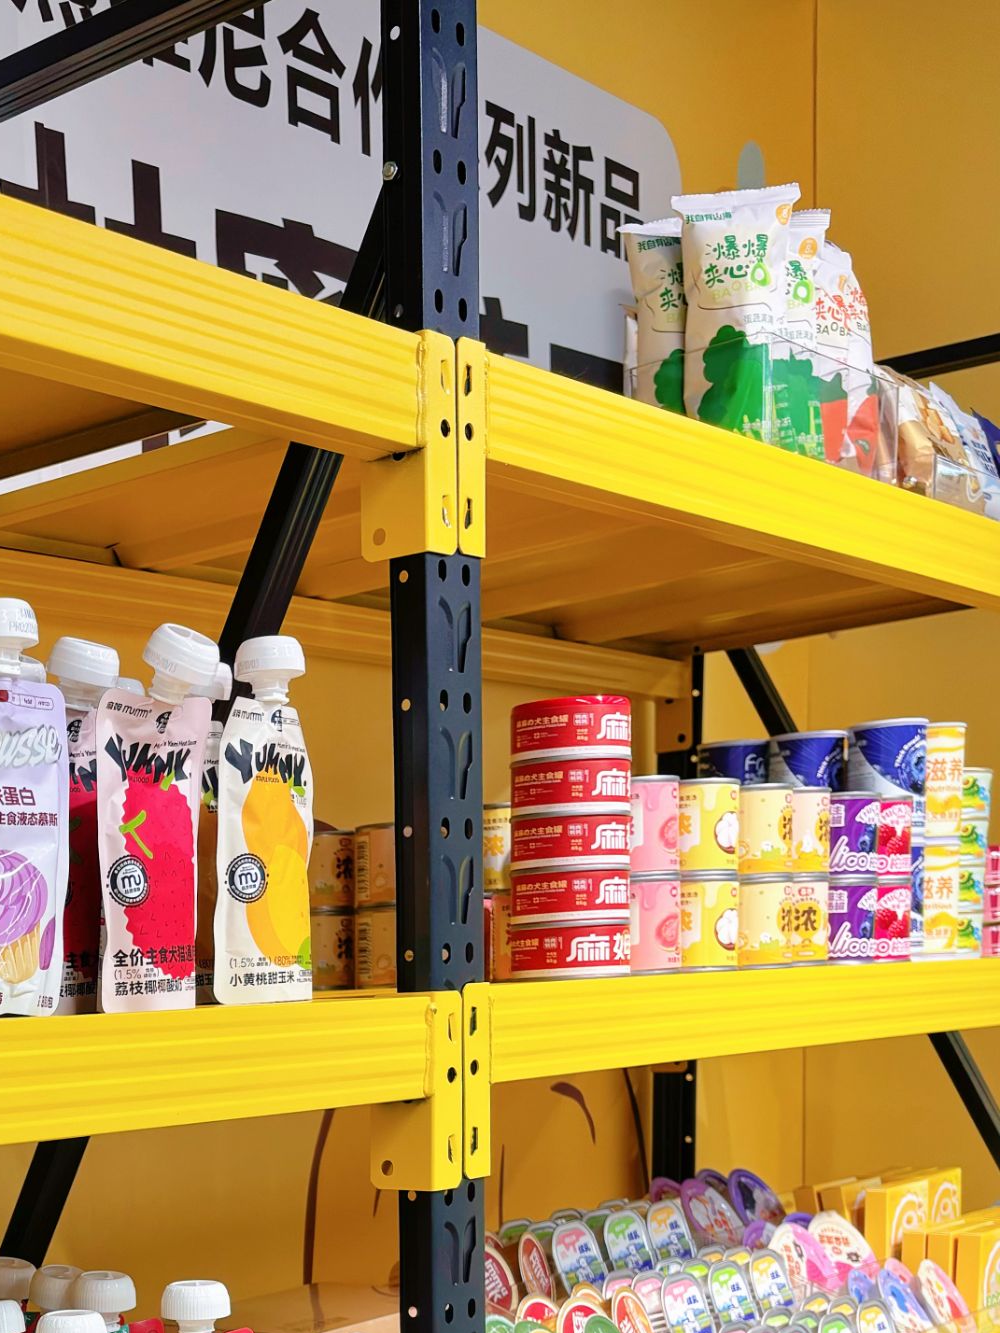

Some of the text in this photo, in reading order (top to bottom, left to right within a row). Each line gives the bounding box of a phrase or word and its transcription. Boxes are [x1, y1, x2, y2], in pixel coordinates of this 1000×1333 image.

[229, 971, 295, 987] 小黄桃甜玉米
